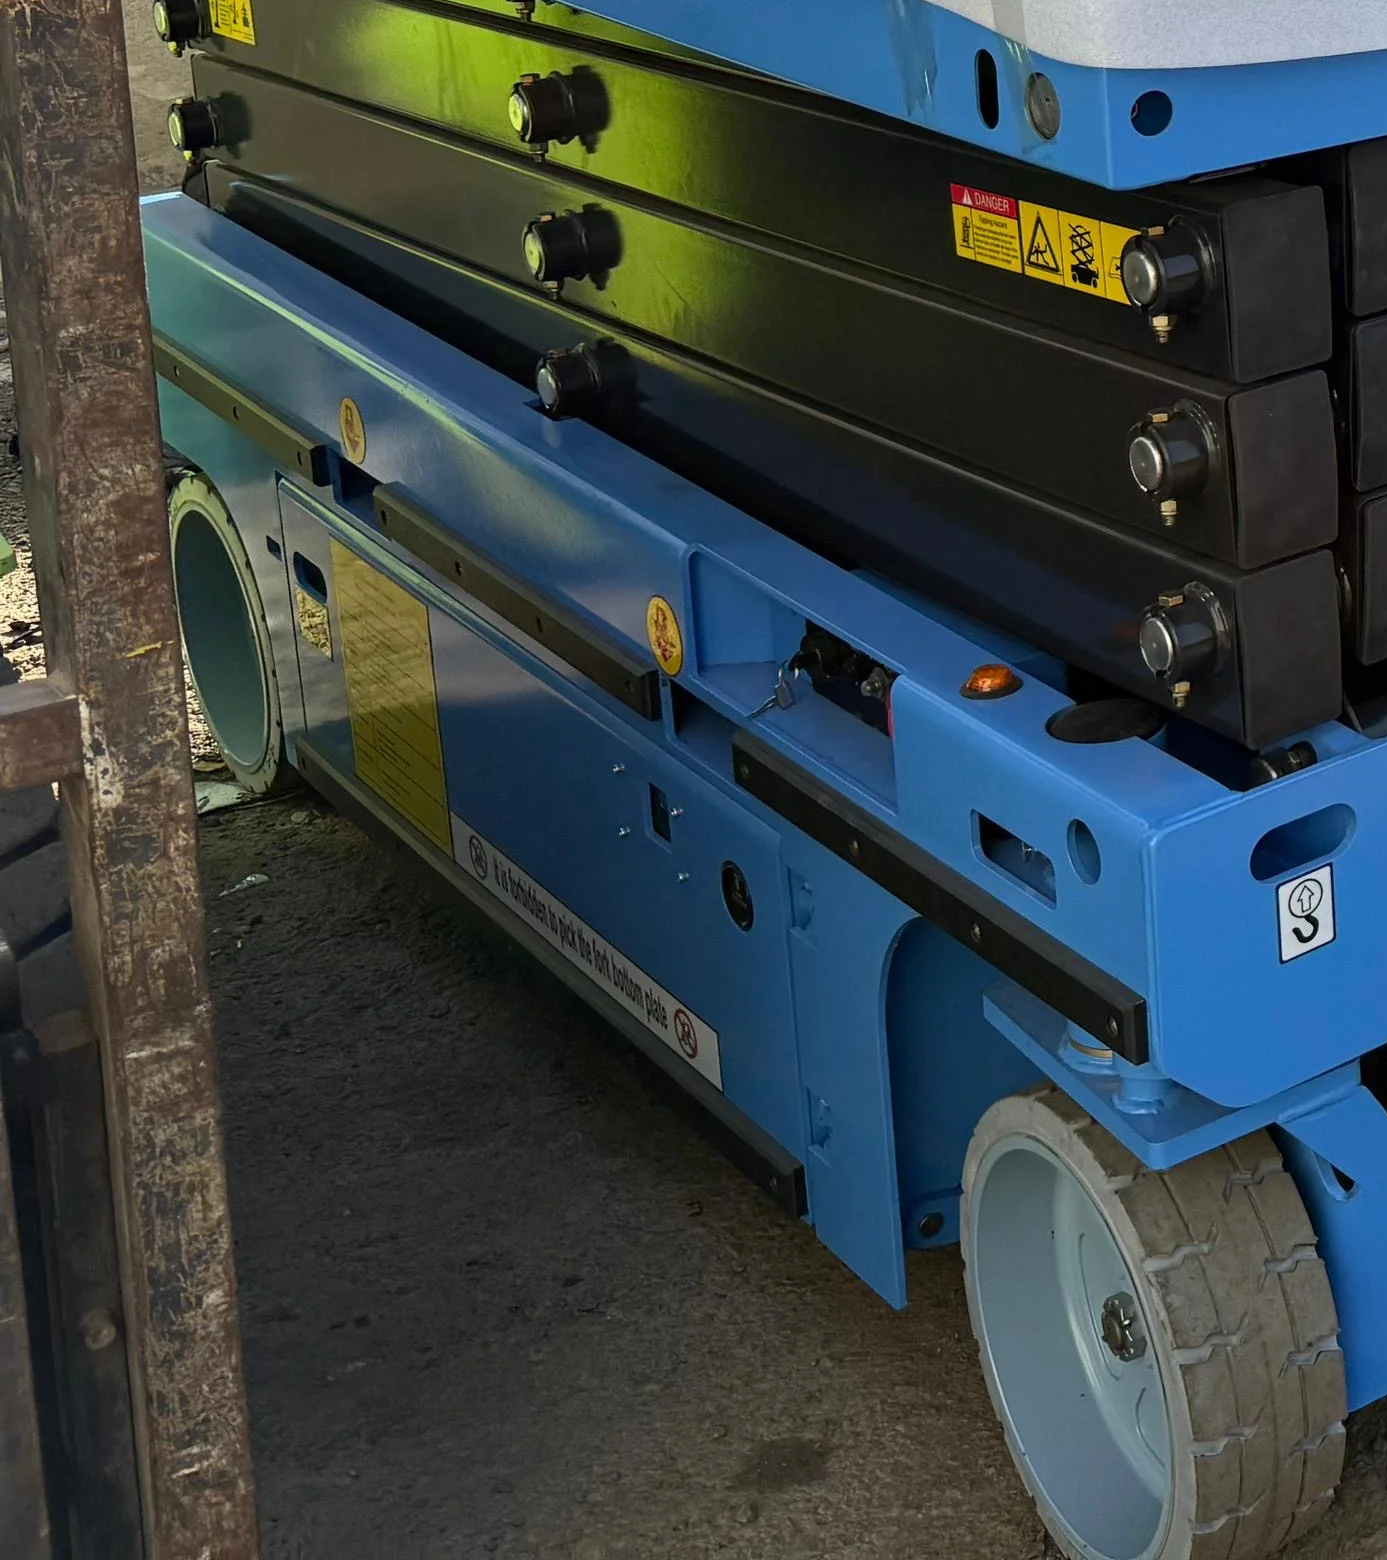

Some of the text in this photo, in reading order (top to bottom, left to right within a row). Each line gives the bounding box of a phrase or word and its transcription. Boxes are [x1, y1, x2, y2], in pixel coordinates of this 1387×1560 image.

[974, 192, 1010, 213] DANGER
[507, 867, 550, 929] forbidden
[558, 914, 579, 953] pick
[611, 955, 645, 1011] bottom
[645, 988, 668, 1031] plate
